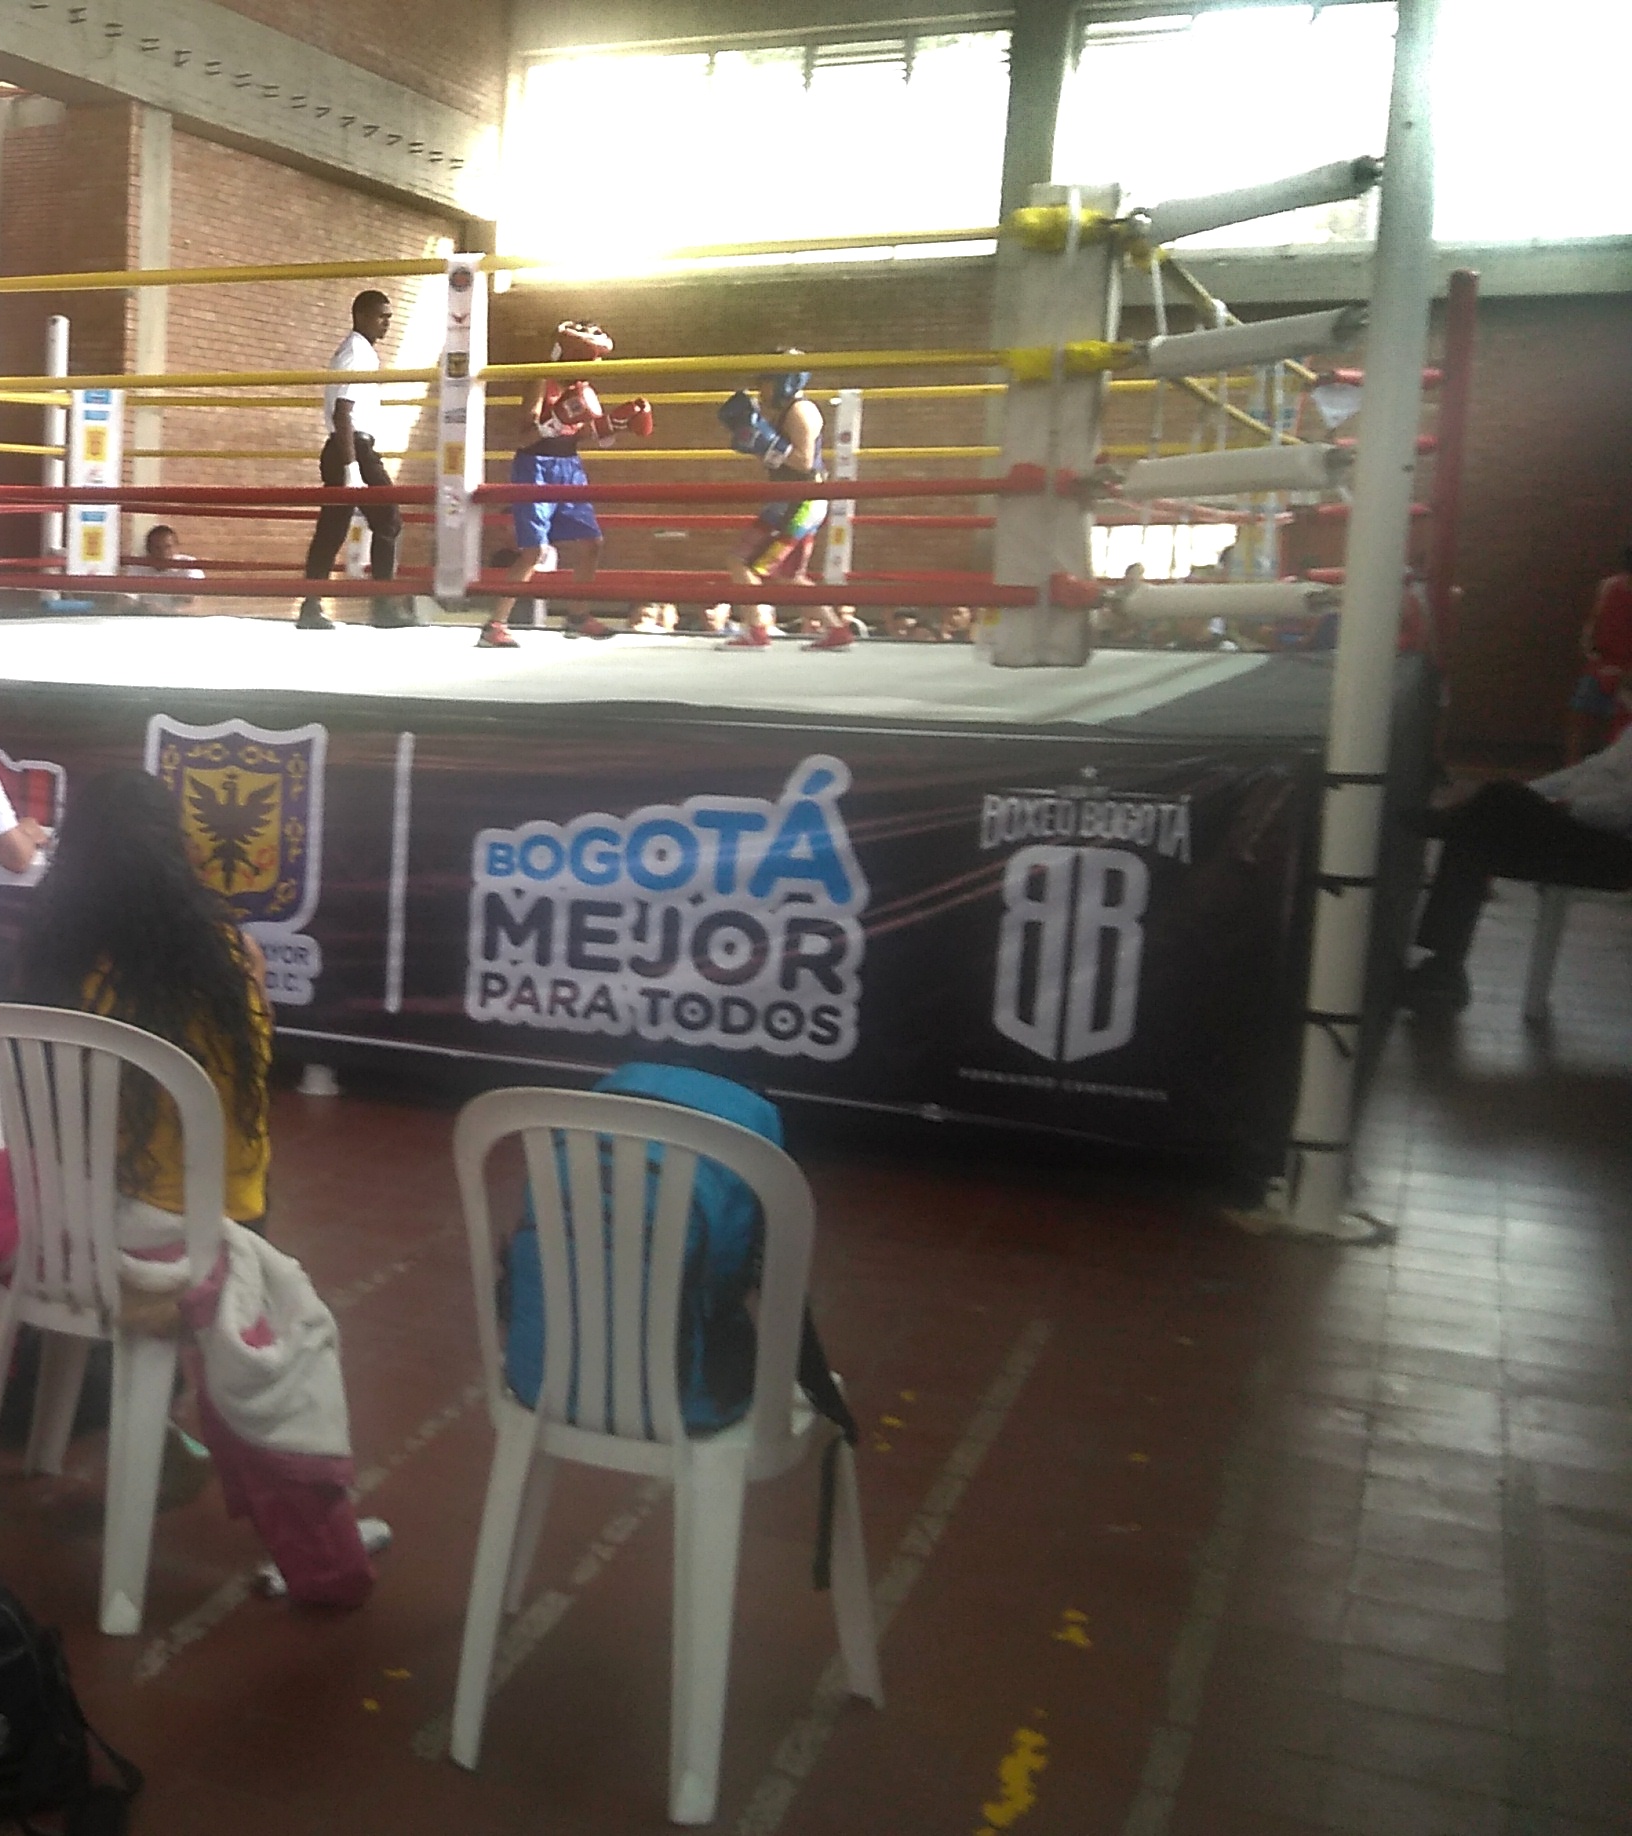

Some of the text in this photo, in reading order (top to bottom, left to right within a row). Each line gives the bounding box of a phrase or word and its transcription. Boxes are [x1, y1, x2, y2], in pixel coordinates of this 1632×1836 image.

[486, 767, 853, 907] BOGOTÁ
[979, 794, 1074, 850] BOXEO
[483, 891, 849, 996] MEJOR
[479, 971, 844, 1047] PARA TODOS
